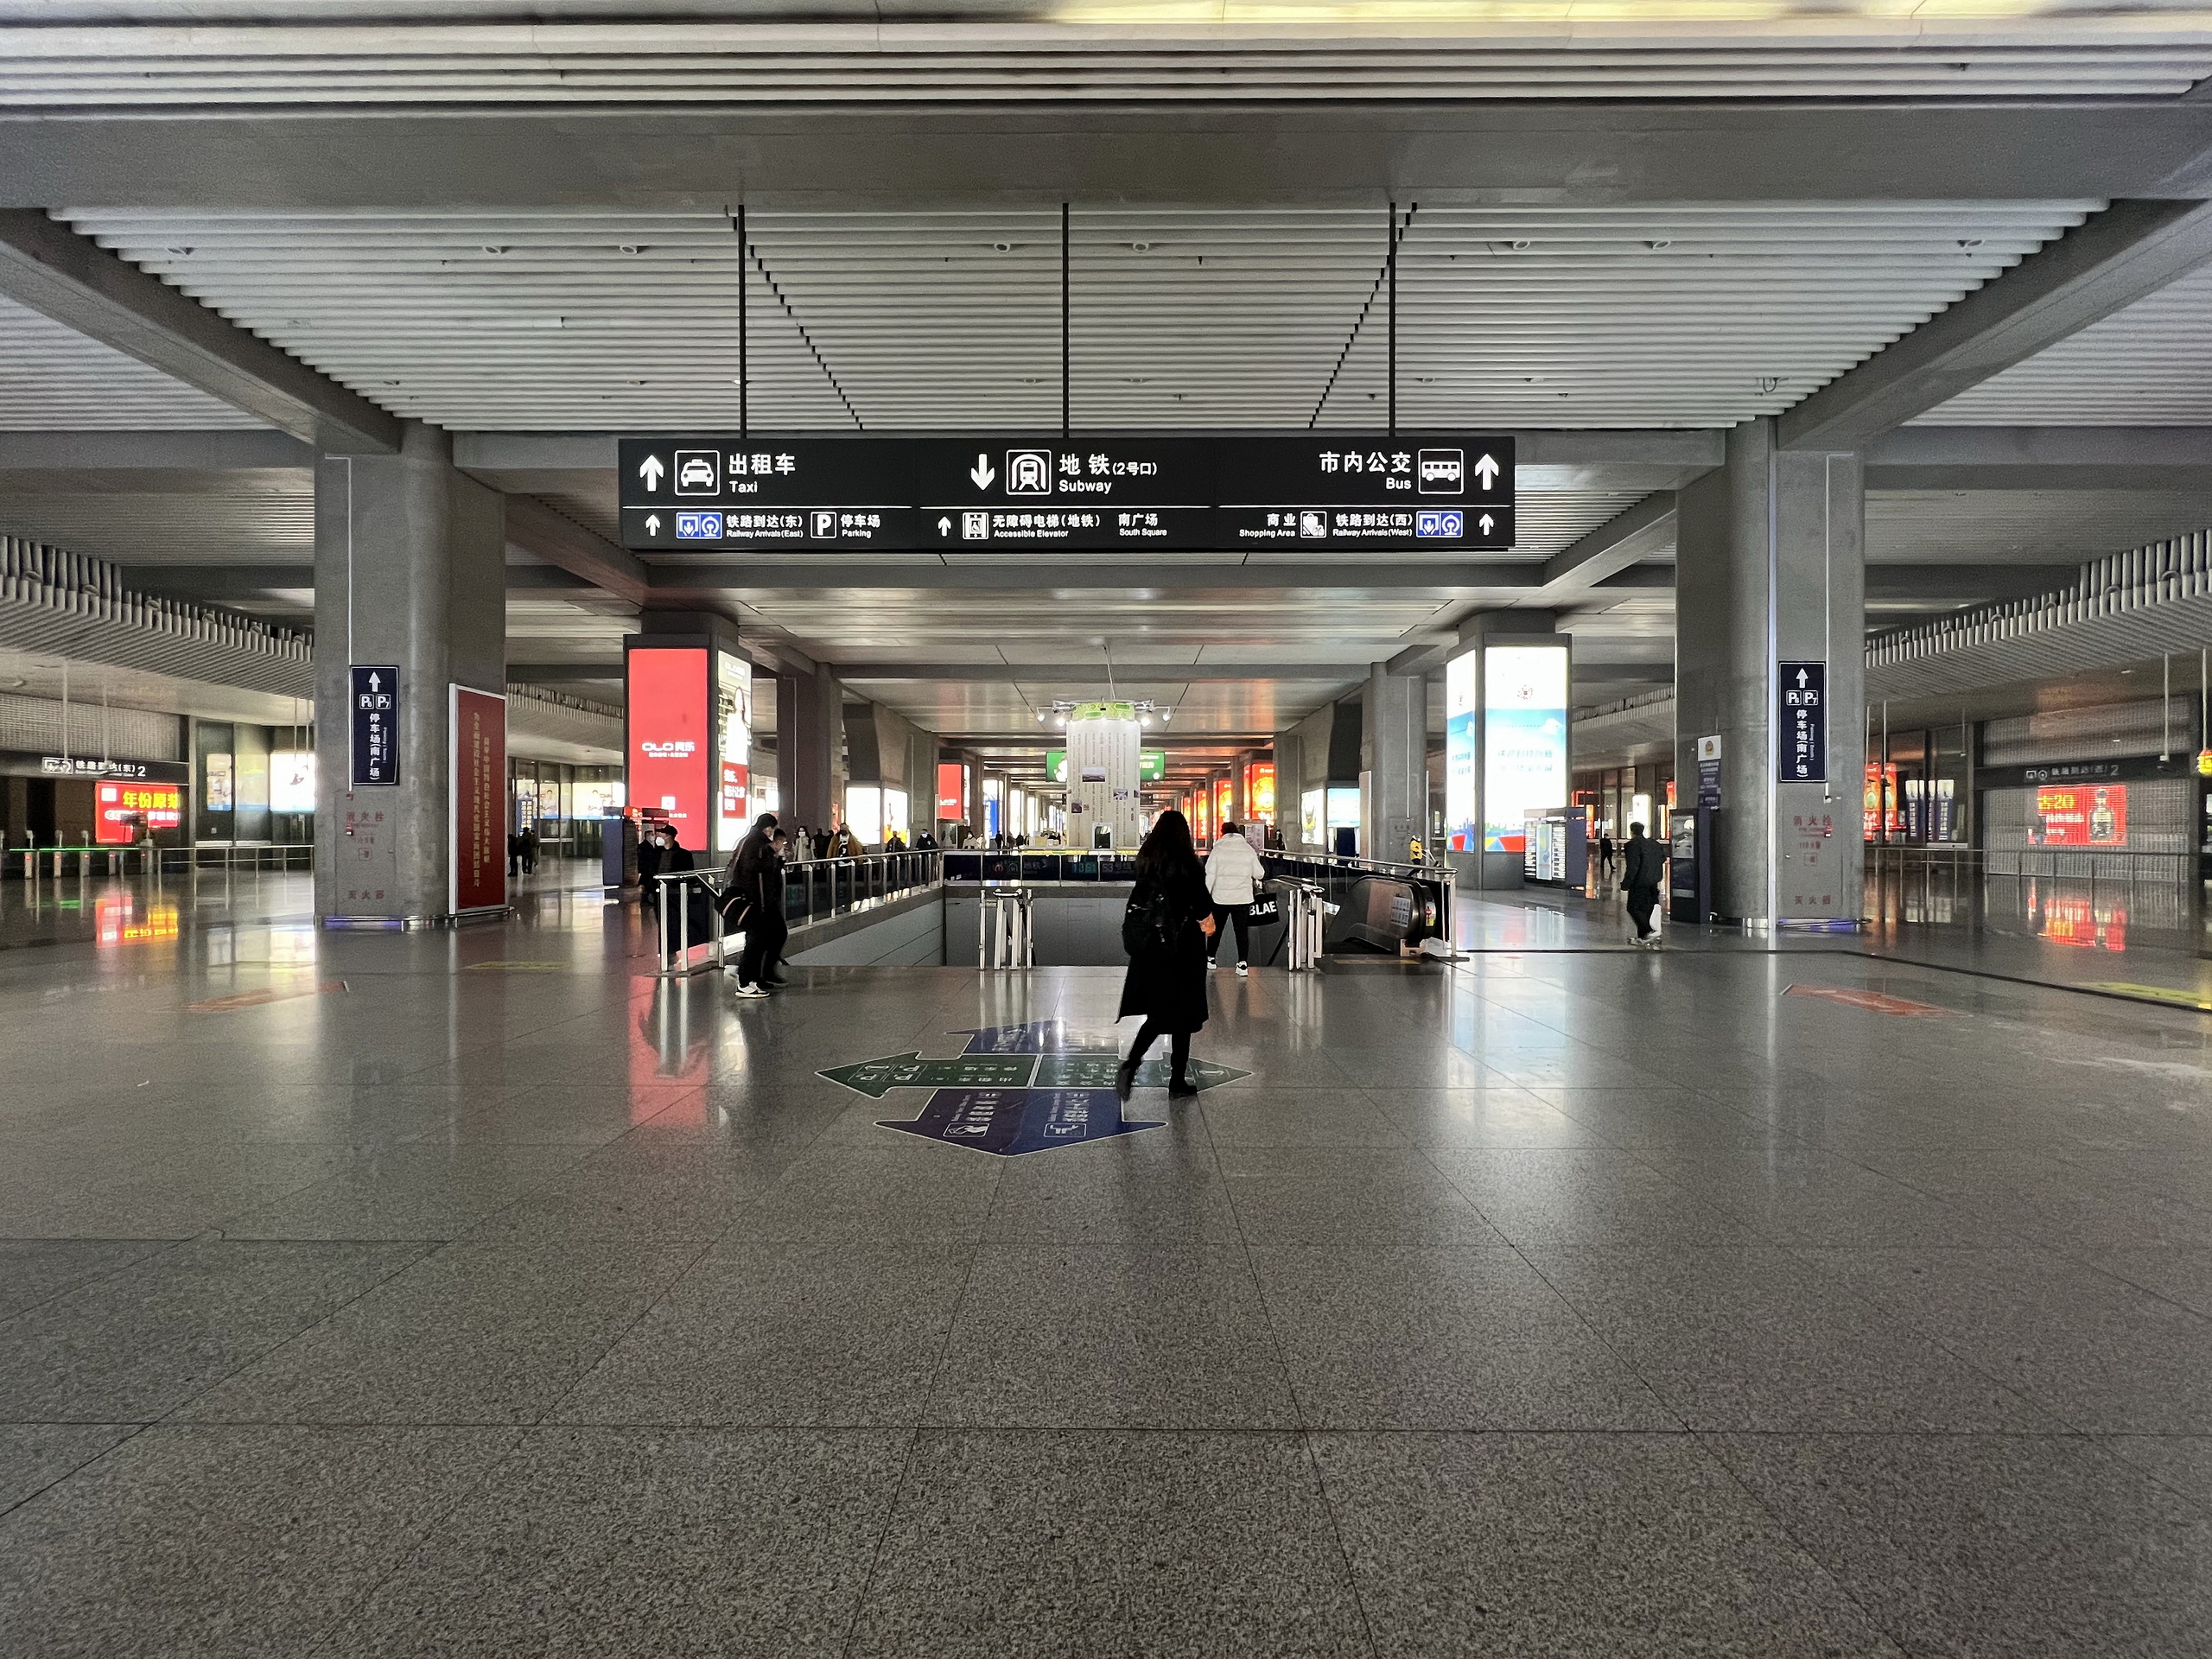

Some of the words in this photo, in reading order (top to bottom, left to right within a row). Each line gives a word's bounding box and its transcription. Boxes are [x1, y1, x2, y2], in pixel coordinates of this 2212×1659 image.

[728, 452, 796, 476] 出租车
[1319, 450, 1412, 474] 市内公交
[728, 480, 758, 493] Taxi
[1058, 479, 1112, 495] Subway
[1385, 476, 1412, 490] Bus
[726, 514, 804, 529] 铁路到达(东)
[840, 513, 880, 528] 停车场
[992, 514, 1101, 529] 无障碍电梯(地铁)
[1117, 512, 1159, 527] 南广场
[1266, 512, 1297, 527] 商业
[1335, 512, 1414, 528] 铁路到达(西)
[726, 529, 754, 539] Railway
[842, 529, 872, 539] Parking
[994, 529, 1036, 538] Accessible
[1037, 529, 1070, 538] Elevator
[1119, 527, 1141, 537] South
[1141, 527, 1167, 537] Square
[1239, 529, 1275, 539] Shopping
[1276, 529, 1296, 538] Area
[1332, 528, 1361, 538] Railway
[1796, 709, 1808, 778] 停车场(南广场)
